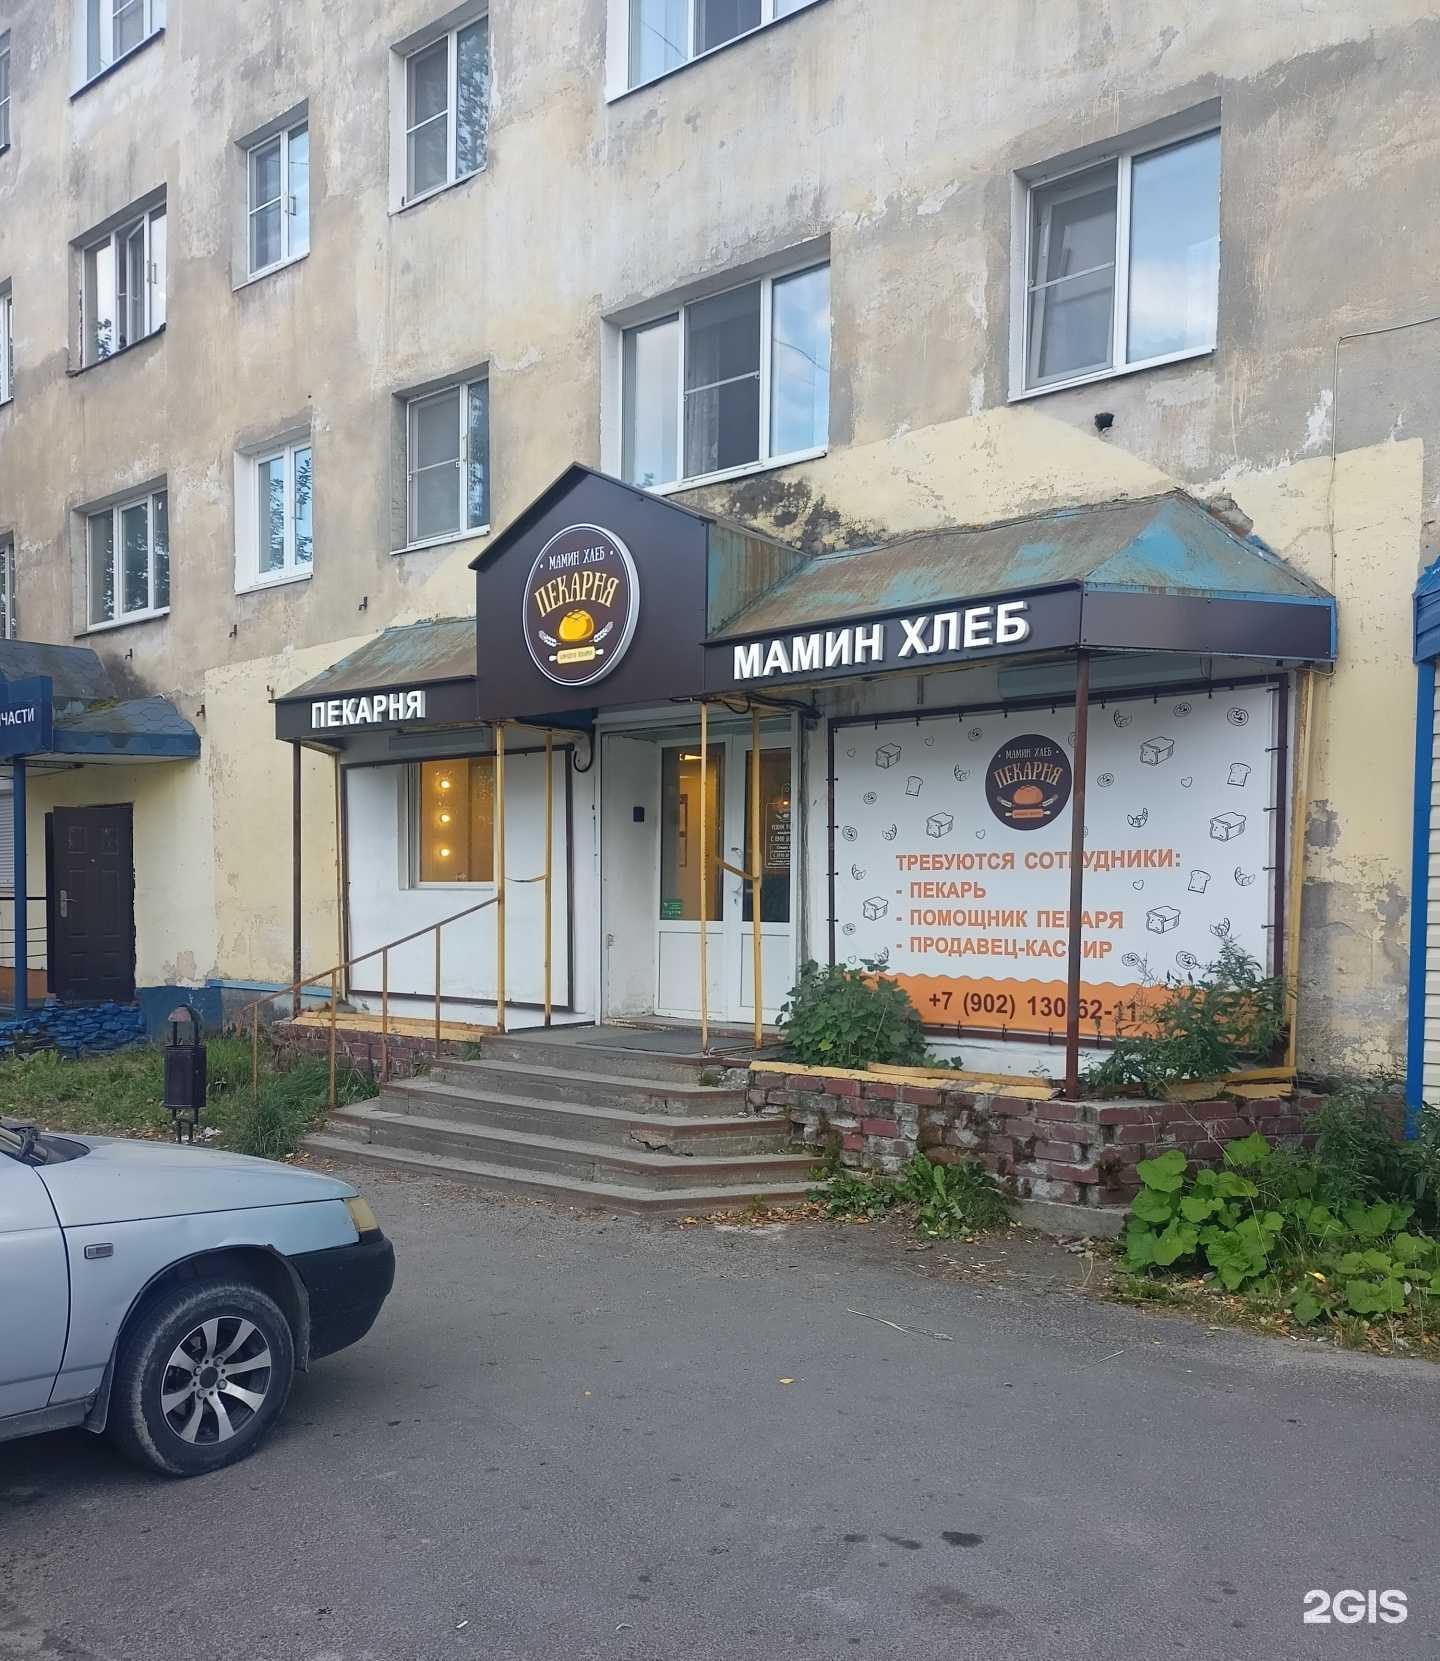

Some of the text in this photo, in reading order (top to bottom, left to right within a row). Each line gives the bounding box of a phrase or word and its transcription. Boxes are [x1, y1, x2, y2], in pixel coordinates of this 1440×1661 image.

[548, 546, 605, 570] МАМИН ХЛЕБ
[534, 571, 620, 618] ПЕКАРНЯ
[733, 600, 1030, 680] МАМИН ХЛЕБ
[0, 707, 35, 727] ЧАСТИ
[311, 690, 426, 728] ПЕКАРНЯ
[1005, 748, 1031, 760] МАМИН
[993, 761, 1063, 789] ПЕКАРНЯ
[896, 849, 1181, 872] ТРЕБУЮТСЯ СОТУДНИКИ:
[910, 881, 986, 899] ПЕКАРЬ
[910, 909, 1027, 930] ПОМОЩНИК
[910, 936, 1113, 959] ПРОДАВЕЦ-КАСИР
[929, 991, 1137, 1023] +7 (902) 13062-11
